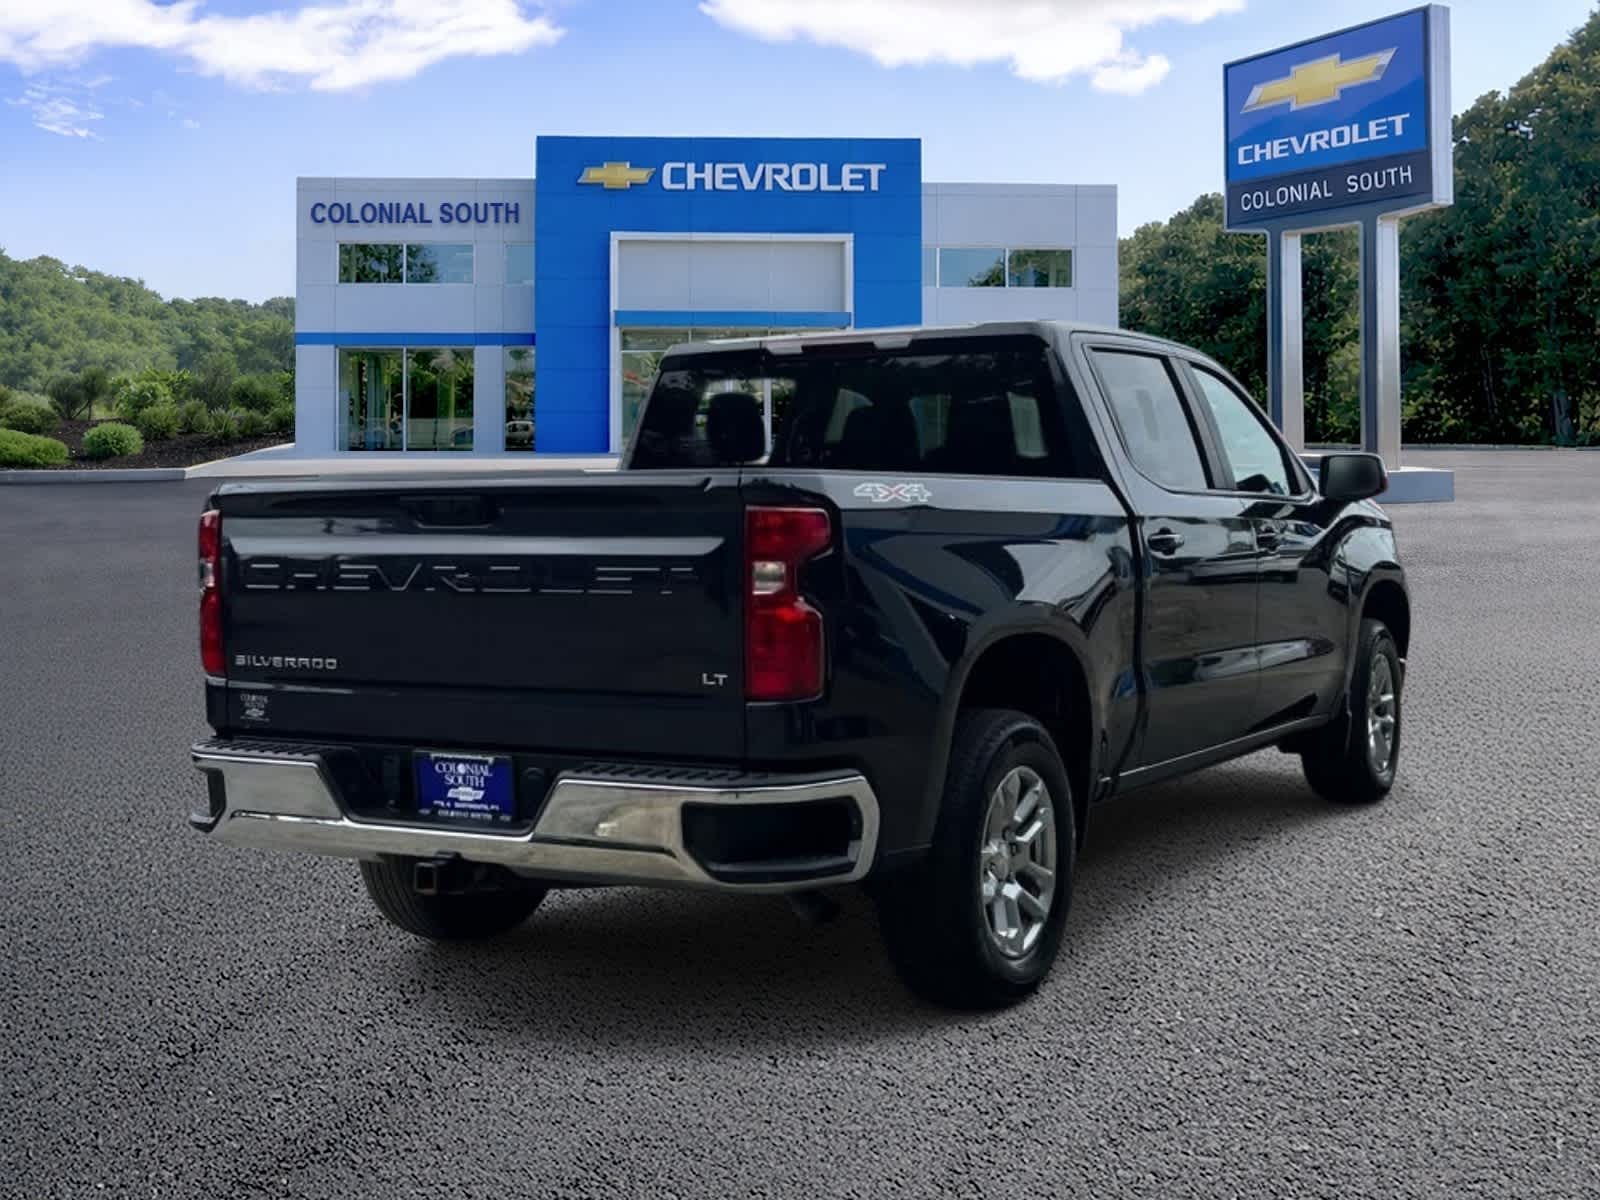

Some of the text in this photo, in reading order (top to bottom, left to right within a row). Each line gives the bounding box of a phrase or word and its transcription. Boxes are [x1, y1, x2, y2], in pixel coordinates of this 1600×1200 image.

[1238, 113, 1410, 165] CHEVROLET
[661, 162, 886, 192] CHEVROLET
[1241, 165, 1412, 211] COLONIAL SOUTH
[310, 202, 520, 224] COLONIAL SOUTH
[245, 562, 695, 595] CHEVROLET
[235, 655, 337, 670] SILVERADO
[702, 673, 728, 686] LT
[434, 761, 493, 777] COLONIAL
[444, 774, 485, 788] SOUTH
